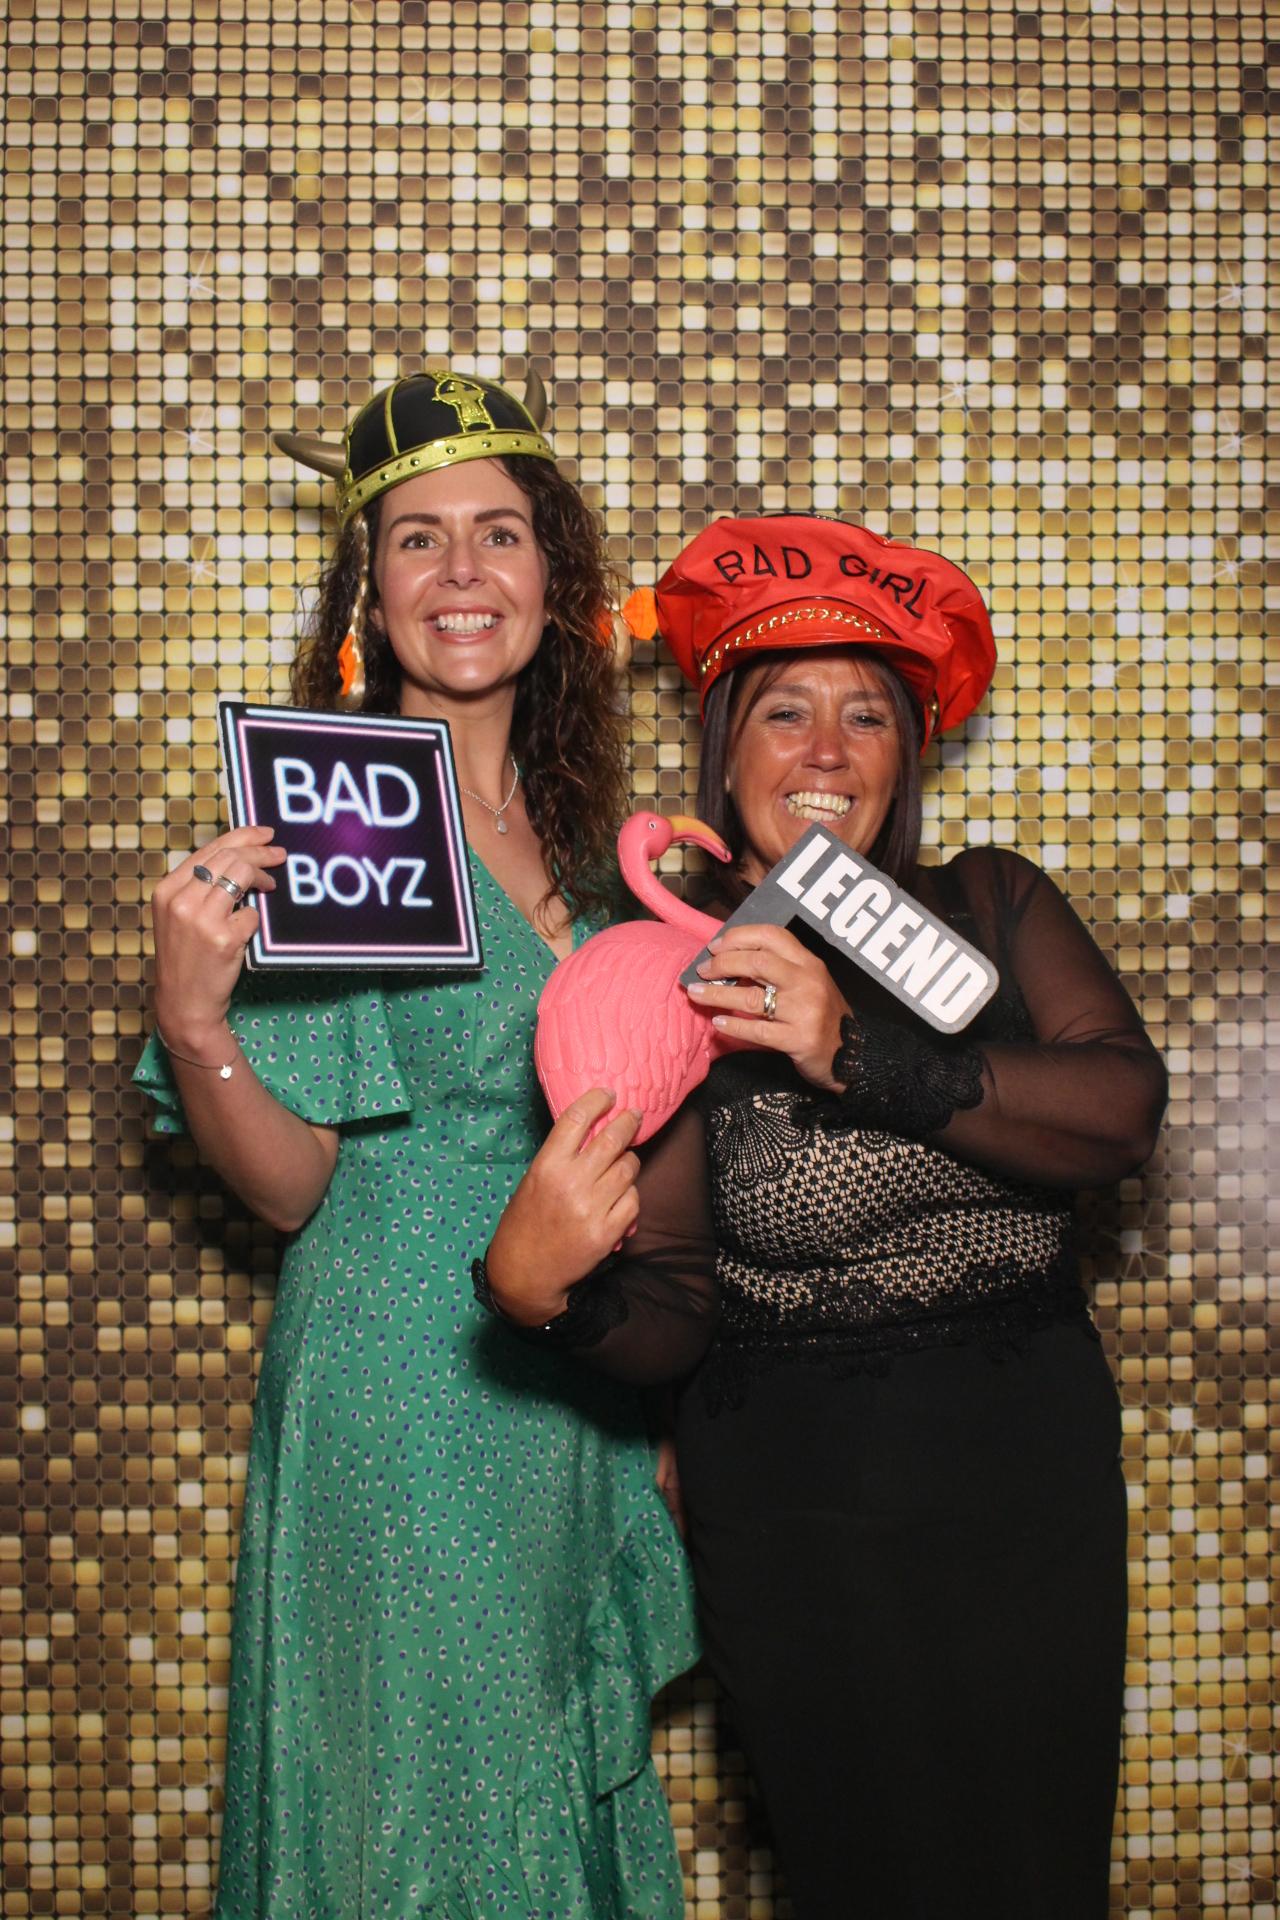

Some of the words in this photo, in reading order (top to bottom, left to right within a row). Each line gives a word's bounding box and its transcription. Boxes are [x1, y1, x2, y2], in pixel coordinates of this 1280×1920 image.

[713, 544, 812, 583] BAD
[839, 554, 928, 619] GIRL
[273, 757, 420, 828] BAD
[286, 854, 433, 907] BOYZ
[776, 833, 988, 1024] LEGEND
